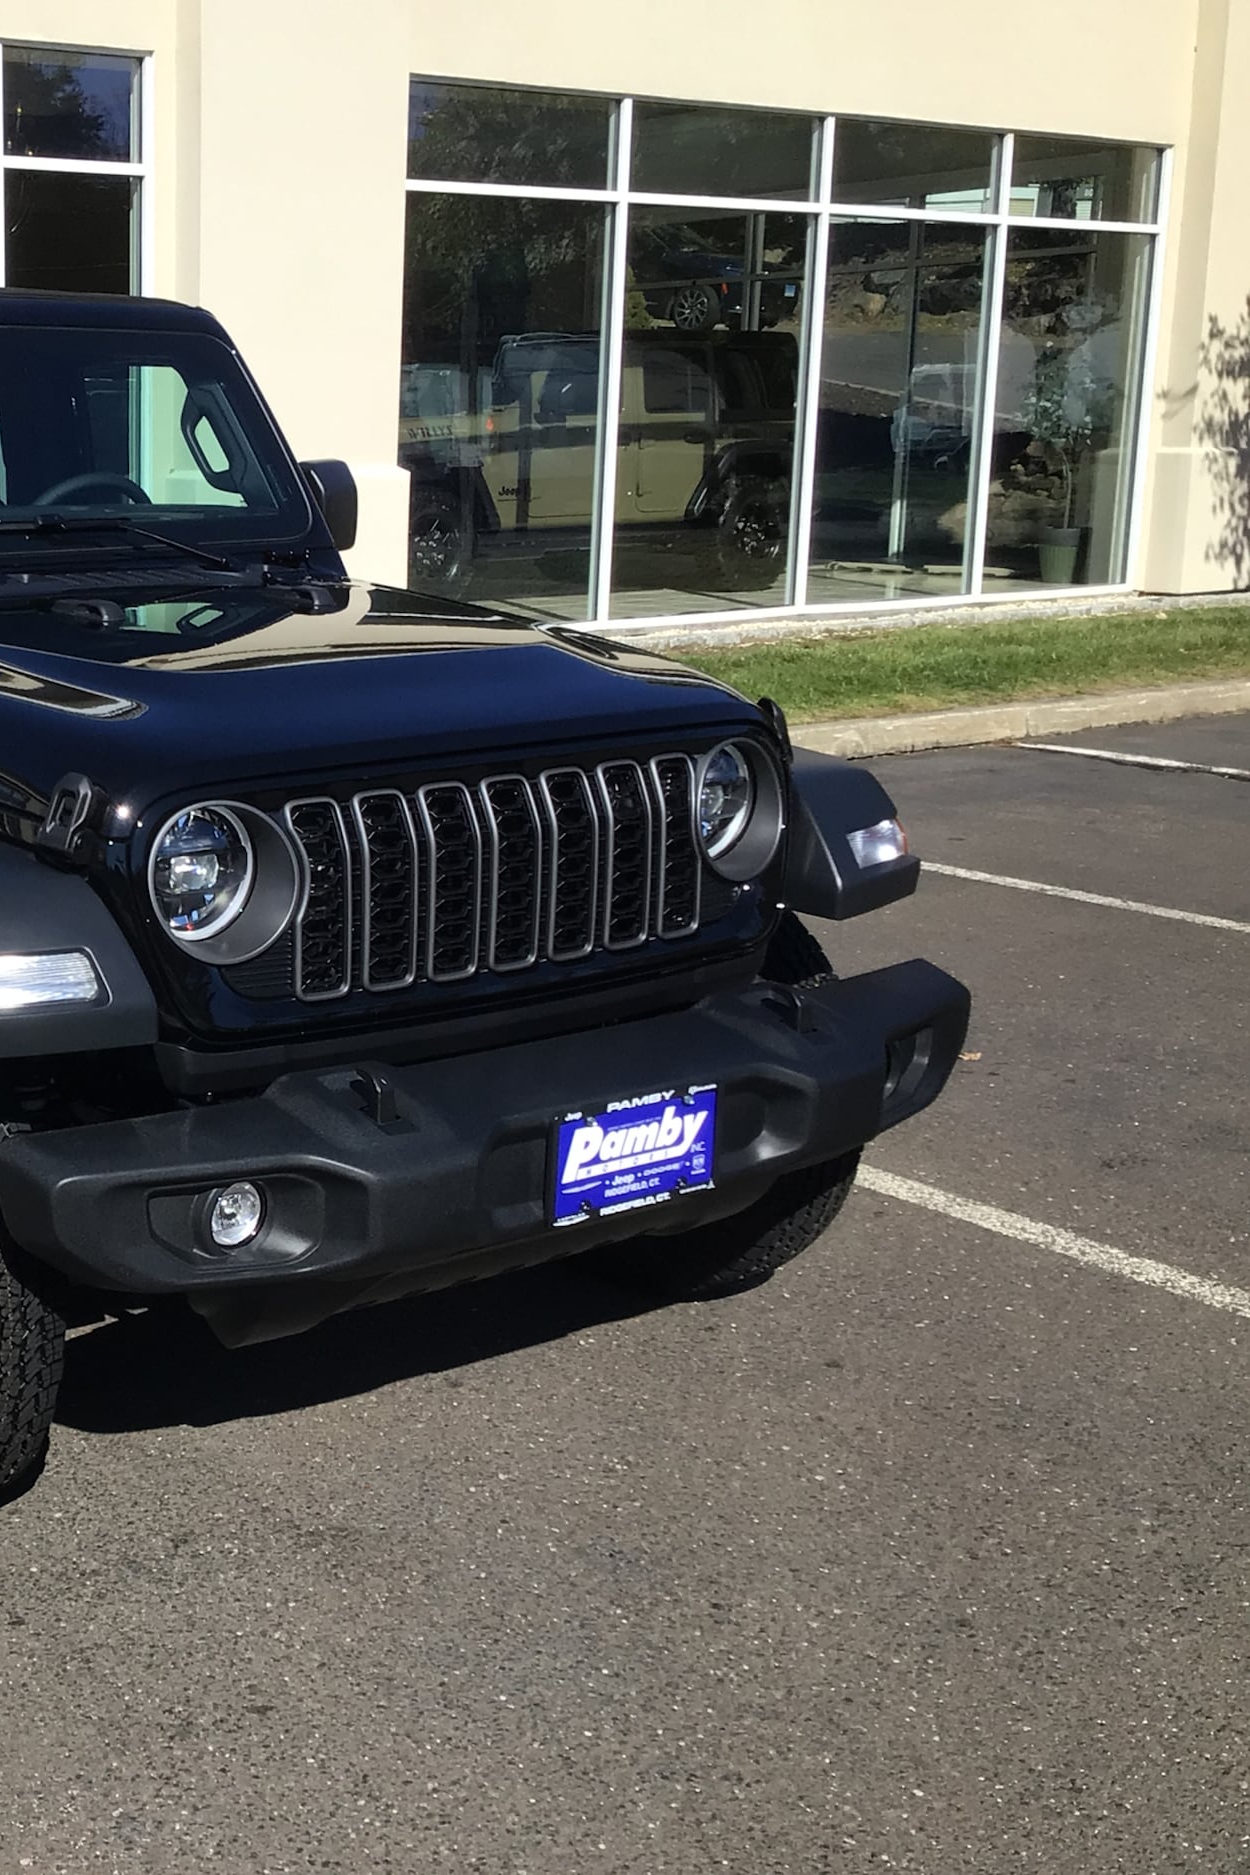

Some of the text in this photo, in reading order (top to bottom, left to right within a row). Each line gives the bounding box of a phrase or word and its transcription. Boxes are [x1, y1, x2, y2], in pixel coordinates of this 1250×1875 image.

[607, 1090, 676, 1113] PAMBY
[561, 1106, 709, 1184] Pamby
[611, 1173, 635, 1186] Jeep
